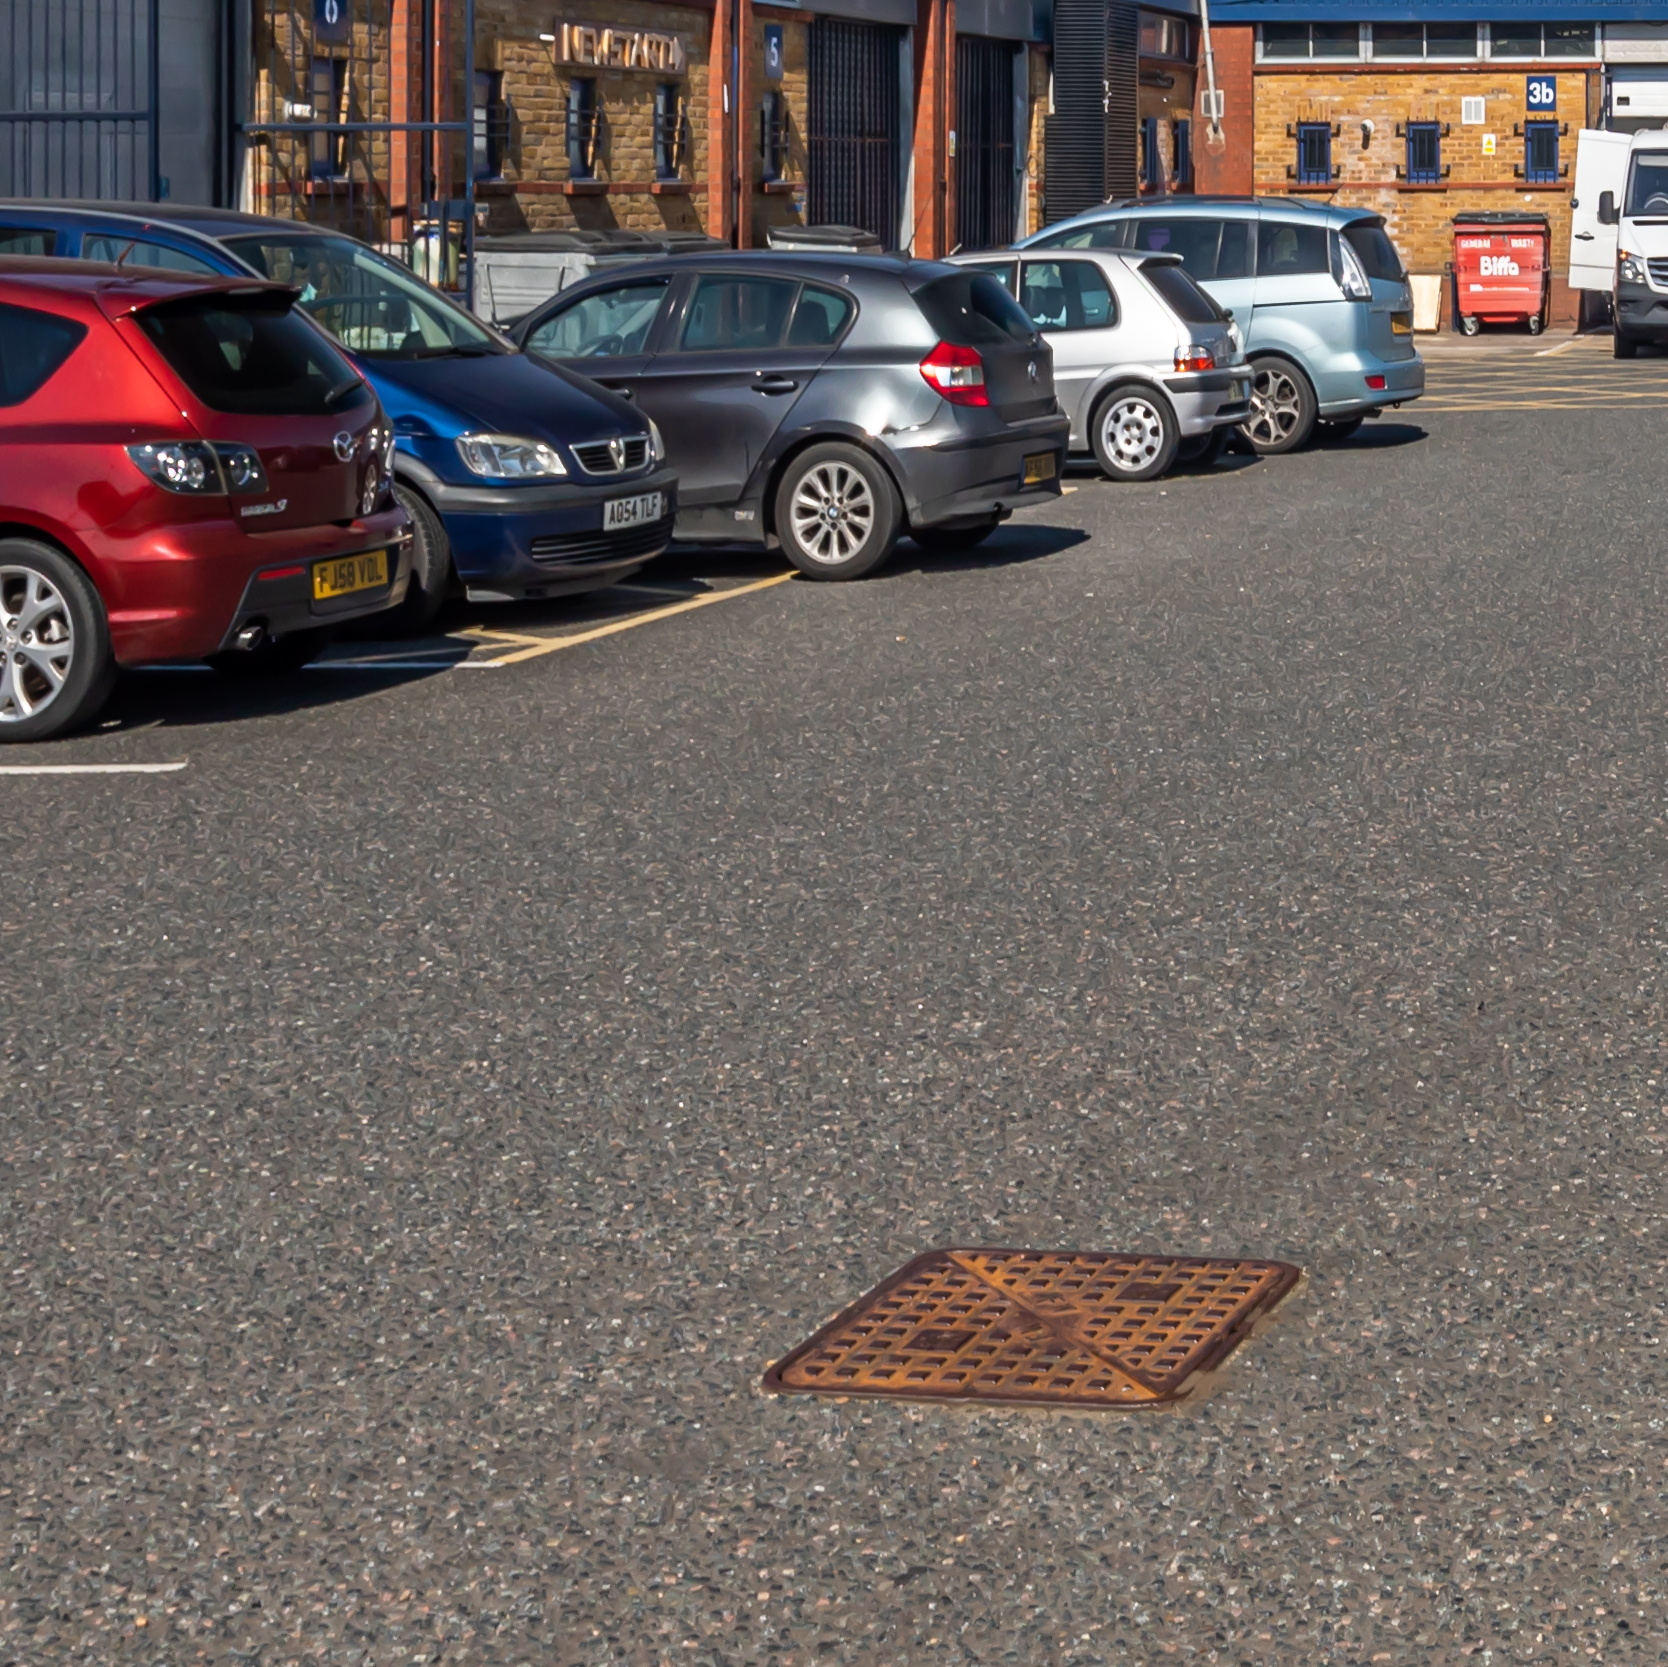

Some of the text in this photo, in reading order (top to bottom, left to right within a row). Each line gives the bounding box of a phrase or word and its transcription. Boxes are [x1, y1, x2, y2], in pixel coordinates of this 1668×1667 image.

[770, 36, 778, 67] 5
[1528, 82, 1554, 104] 3b
[1480, 255, 1520, 276] Biffa
[640, 495, 658, 519] TLF
